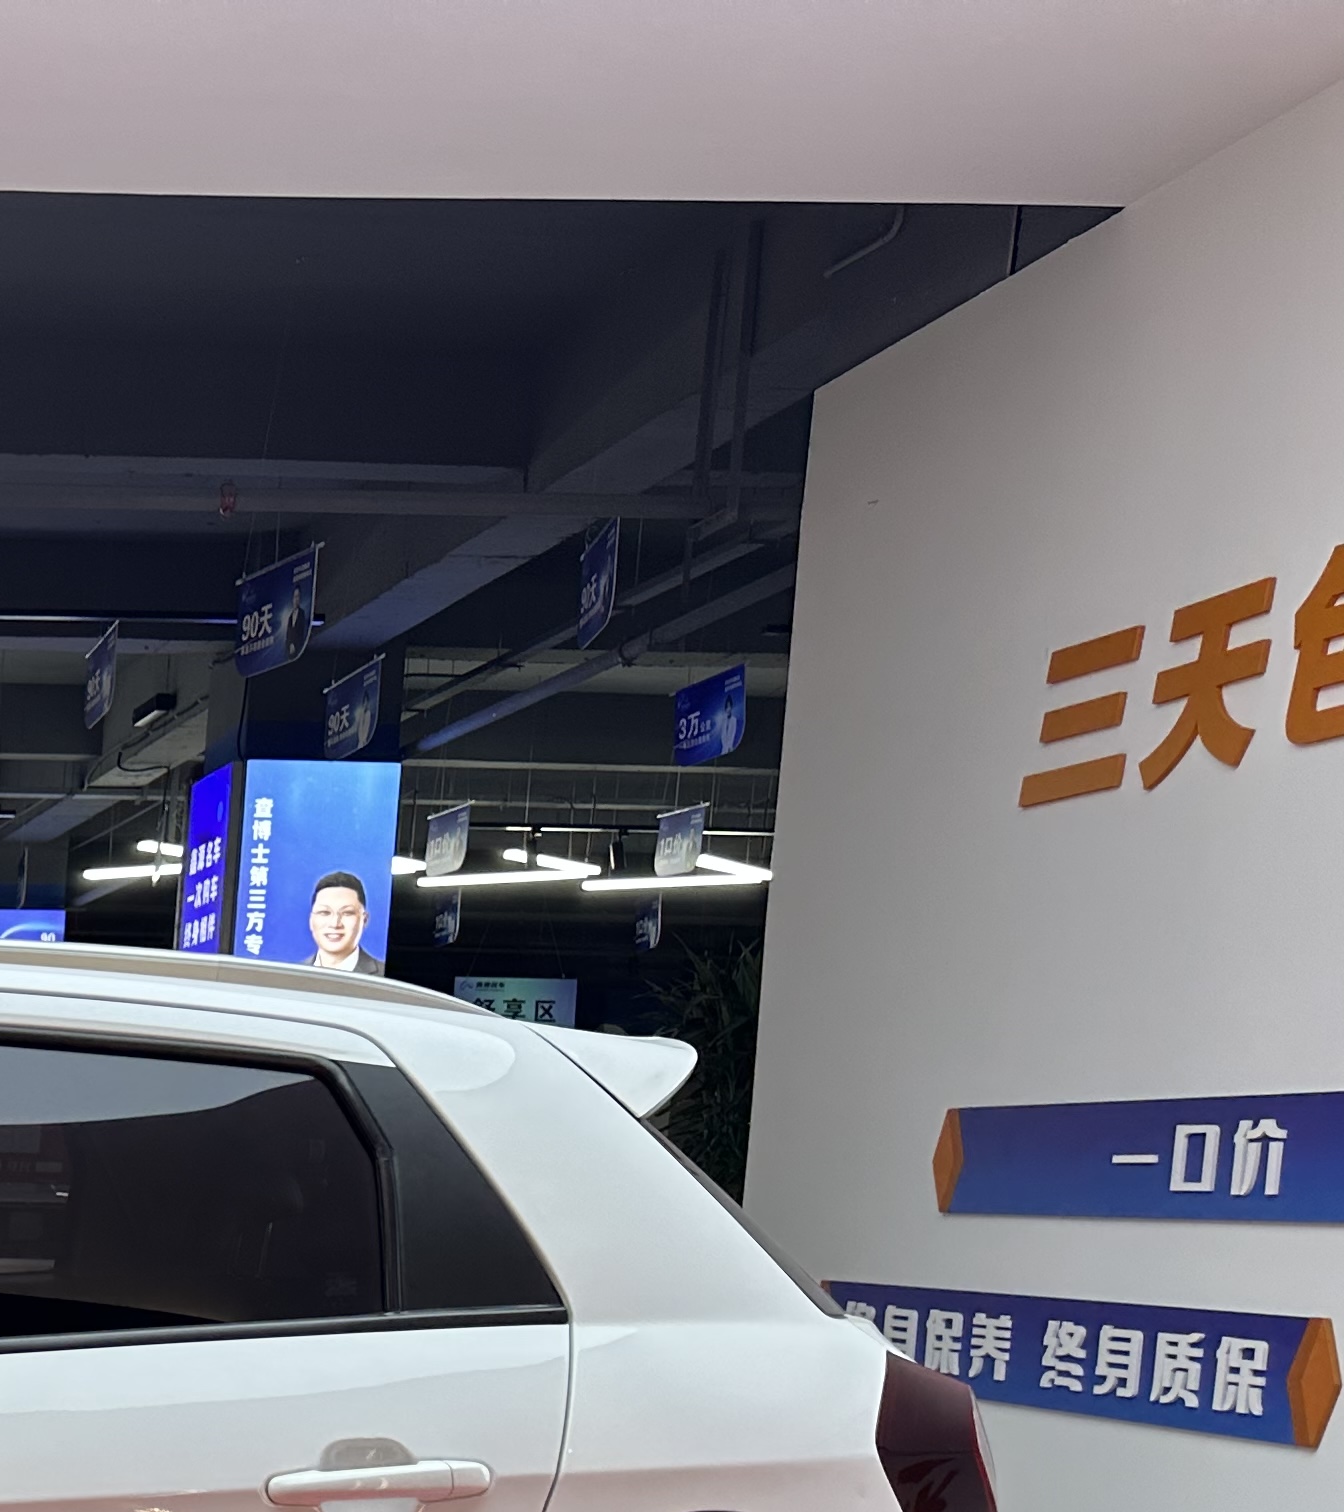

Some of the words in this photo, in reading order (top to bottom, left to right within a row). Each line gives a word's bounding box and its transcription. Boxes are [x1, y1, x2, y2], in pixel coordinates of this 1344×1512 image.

[242, 602, 273, 641] 90天
[327, 704, 350, 735] 90天
[1111, 1118, 1288, 1197] 一口价
[1039, 1320, 1270, 1417] 终身质保
